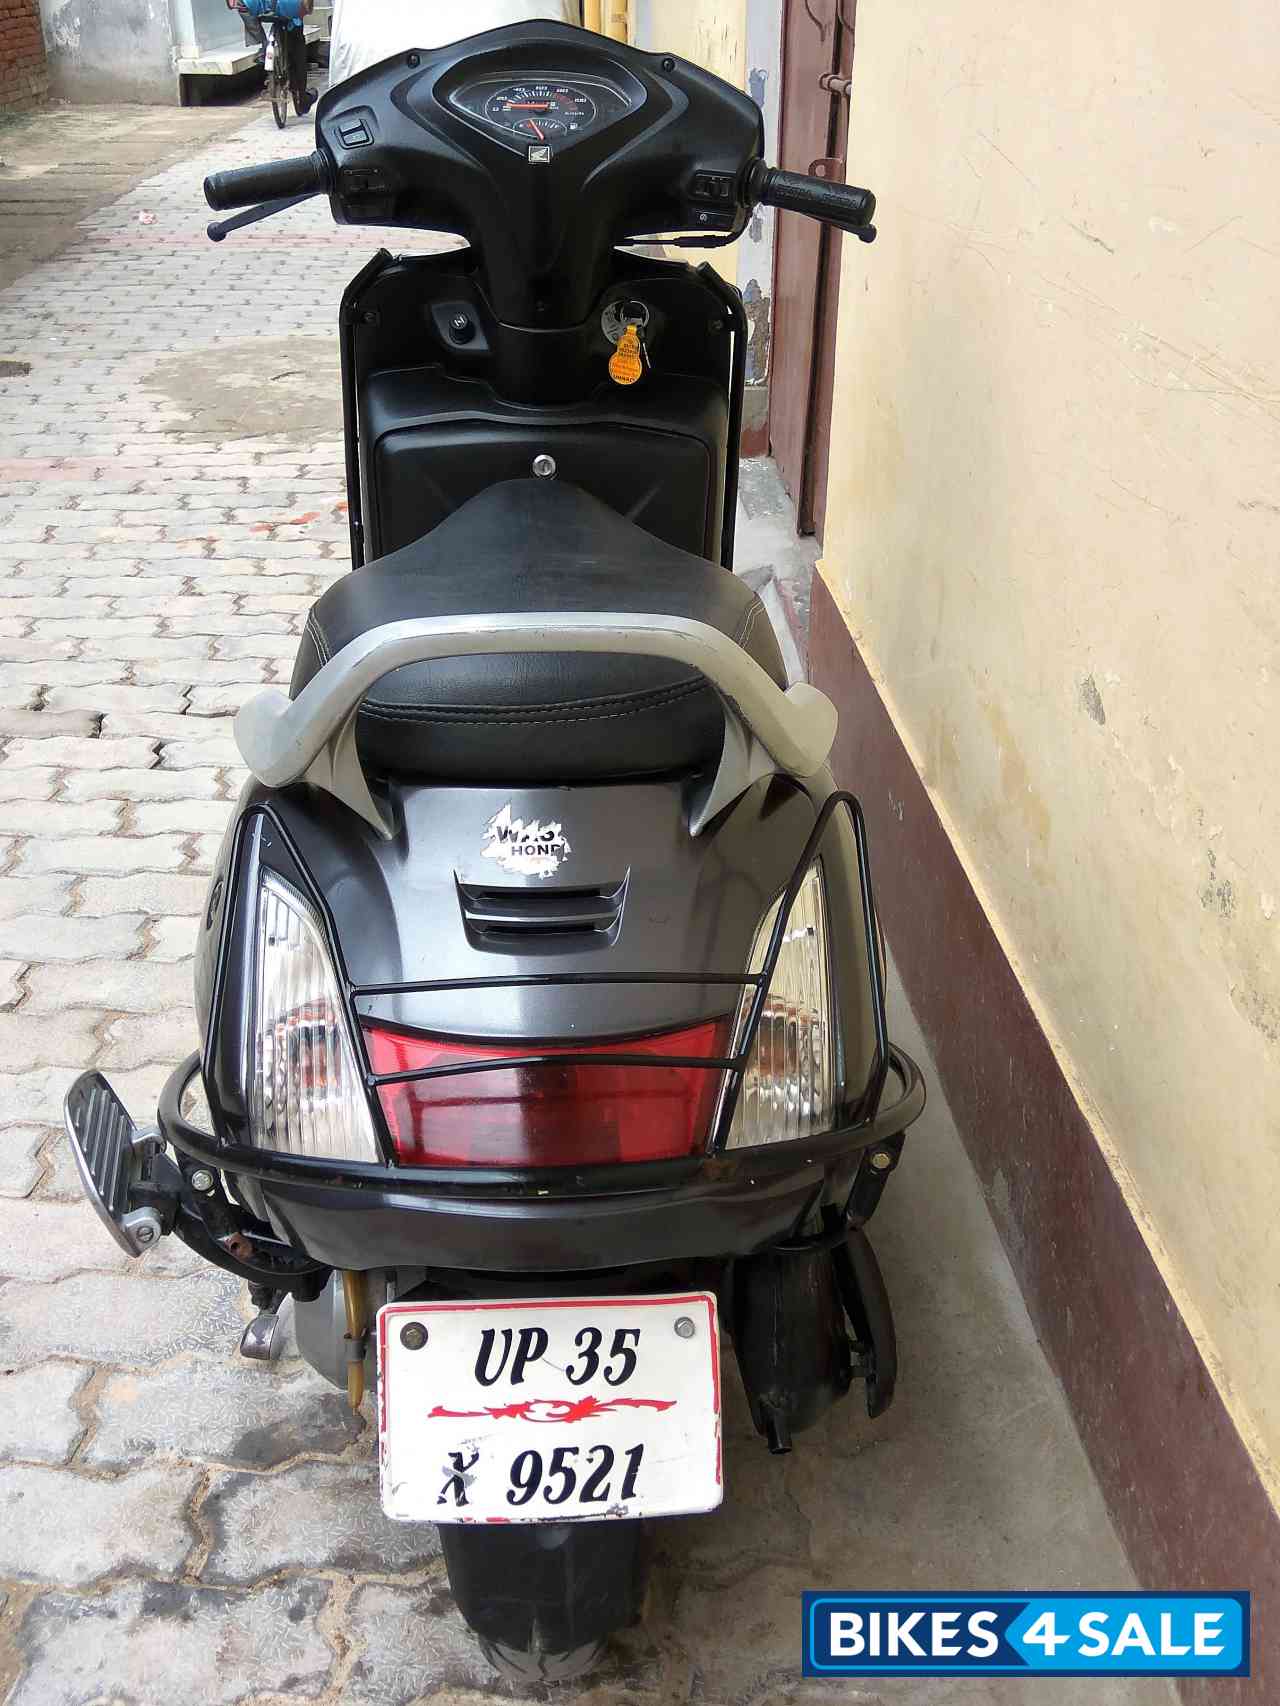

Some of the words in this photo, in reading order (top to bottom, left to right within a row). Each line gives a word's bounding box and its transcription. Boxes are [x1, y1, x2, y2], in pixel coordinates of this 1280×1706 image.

[475, 1327, 549, 1386] UP
[566, 1326, 641, 1386] 35
[437, 1451, 480, 1507] X
[507, 1443, 644, 1506] 9521
